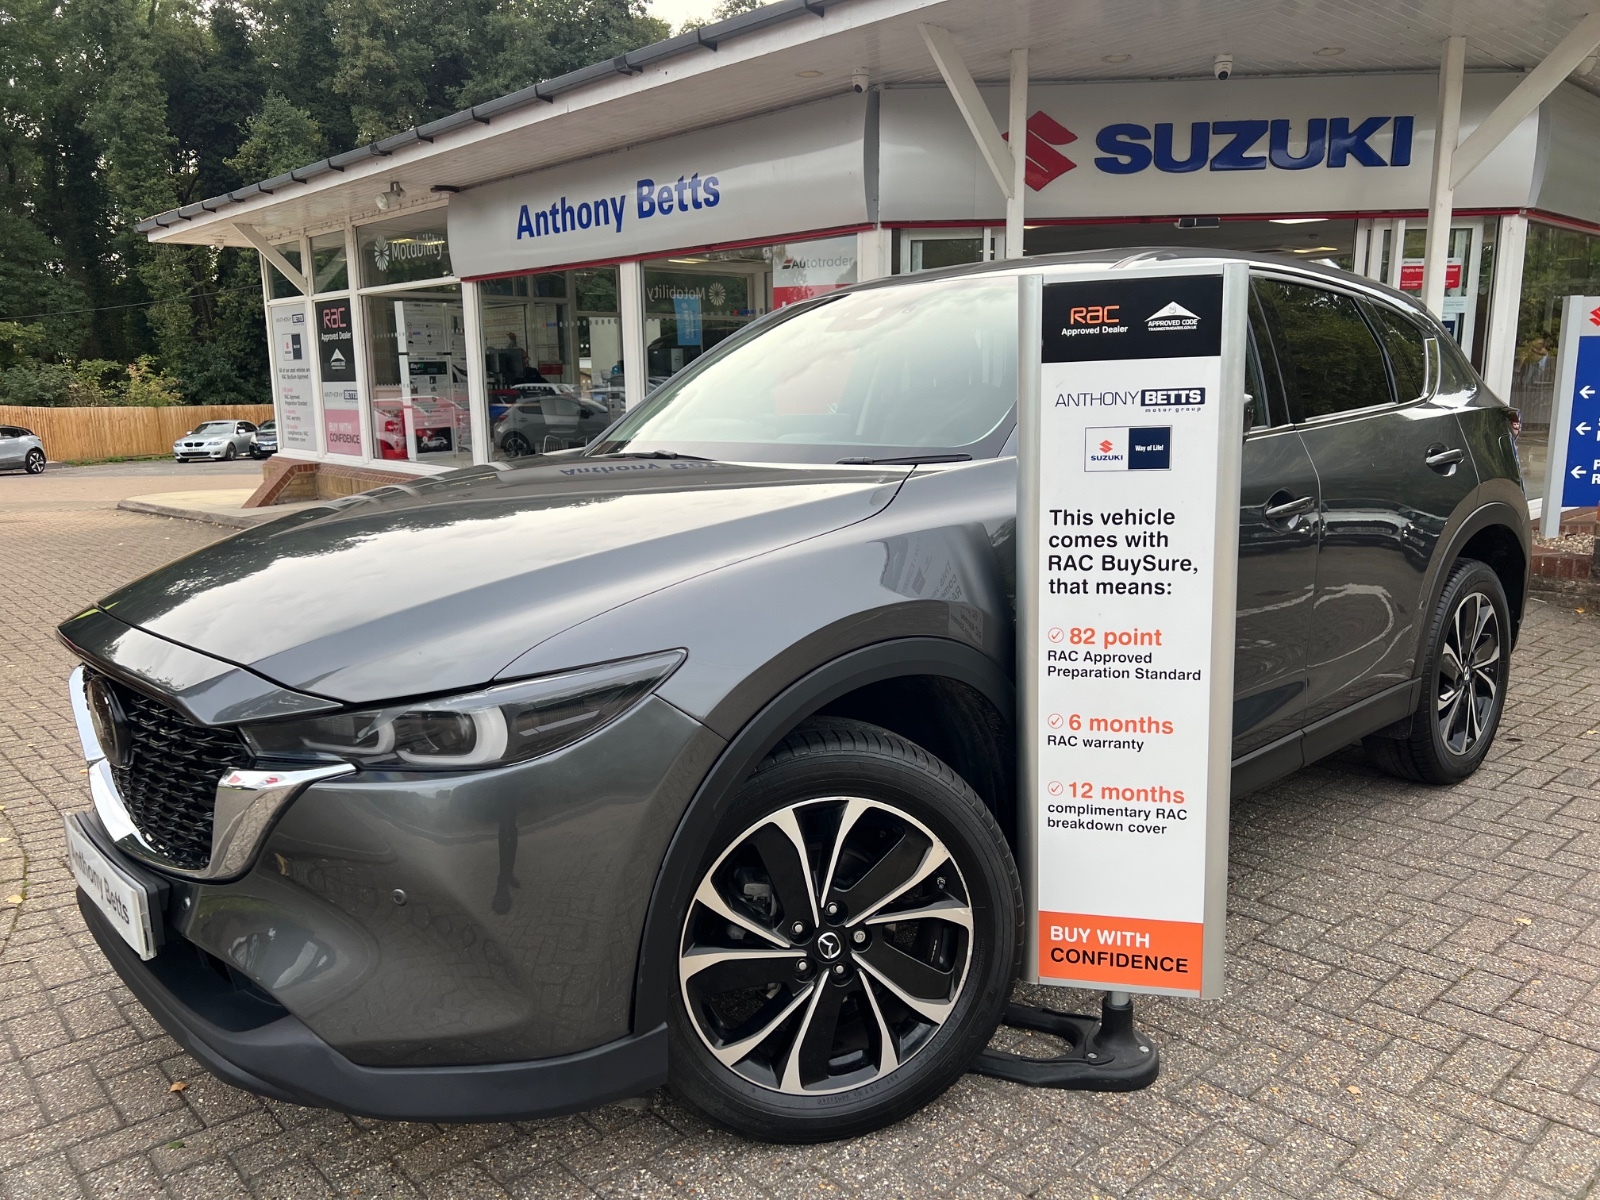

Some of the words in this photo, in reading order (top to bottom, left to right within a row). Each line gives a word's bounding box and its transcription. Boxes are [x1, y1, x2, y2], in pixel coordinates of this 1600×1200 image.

[1094, 115, 1414, 174] SUZUKI
[516, 195, 626, 240] Anthony
[636, 172, 720, 219] Betts
[391, 232, 443, 261] Motability
[791, 256, 854, 269] Autotrader
[1061, 326, 1100, 337] Approved
[1102, 325, 1129, 334] Dealer
[1182, 318, 1198, 326] CODE
[321, 332, 339, 342] Approved
[339, 331, 352, 340] Dealer
[1055, 390, 1139, 407] ANTHONY
[1144, 390, 1201, 405] BETTS
[328, 422, 338, 432] BUY
[338, 422, 352, 433] WITH
[330, 433, 361, 445] CONFIDENCE
[1049, 509, 1094, 526] This
[1100, 508, 1176, 526] vehicle
[1048, 534, 1118, 548] comes
[1125, 531, 1169, 548] with
[1048, 554, 1094, 572] RAC
[1101, 554, 1198, 576] BuySure,
[1048, 578, 1089, 595] that
[1096, 581, 1172, 595] means:
[1069, 627, 1096, 645] 82
[1103, 628, 1163, 650] point
[1047, 650, 1079, 662] RAC
[1083, 651, 1152, 665] Approved
[1047, 665, 1130, 680] Preparation
[1135, 667, 1201, 681] Standard
[1068, 713, 1082, 731] 6
[1089, 716, 1174, 735] months
[1047, 734, 1078, 747] RAC
[1082, 738, 1144, 753] warranty
[1068, 781, 1093, 799] 12
[1101, 785, 1185, 804] months
[1047, 804, 1151, 821] complimentary
[1156, 808, 1188, 821] RAC
[1047, 816, 1123, 832] breakdown
[1128, 823, 1167, 834] cover
[70, 839, 104, 900] Anthony
[103, 876, 130, 926] Betts
[1050, 925, 1091, 944] BUY
[1096, 929, 1150, 949] WITH
[1050, 947, 1189, 973] CONFIDENCE
